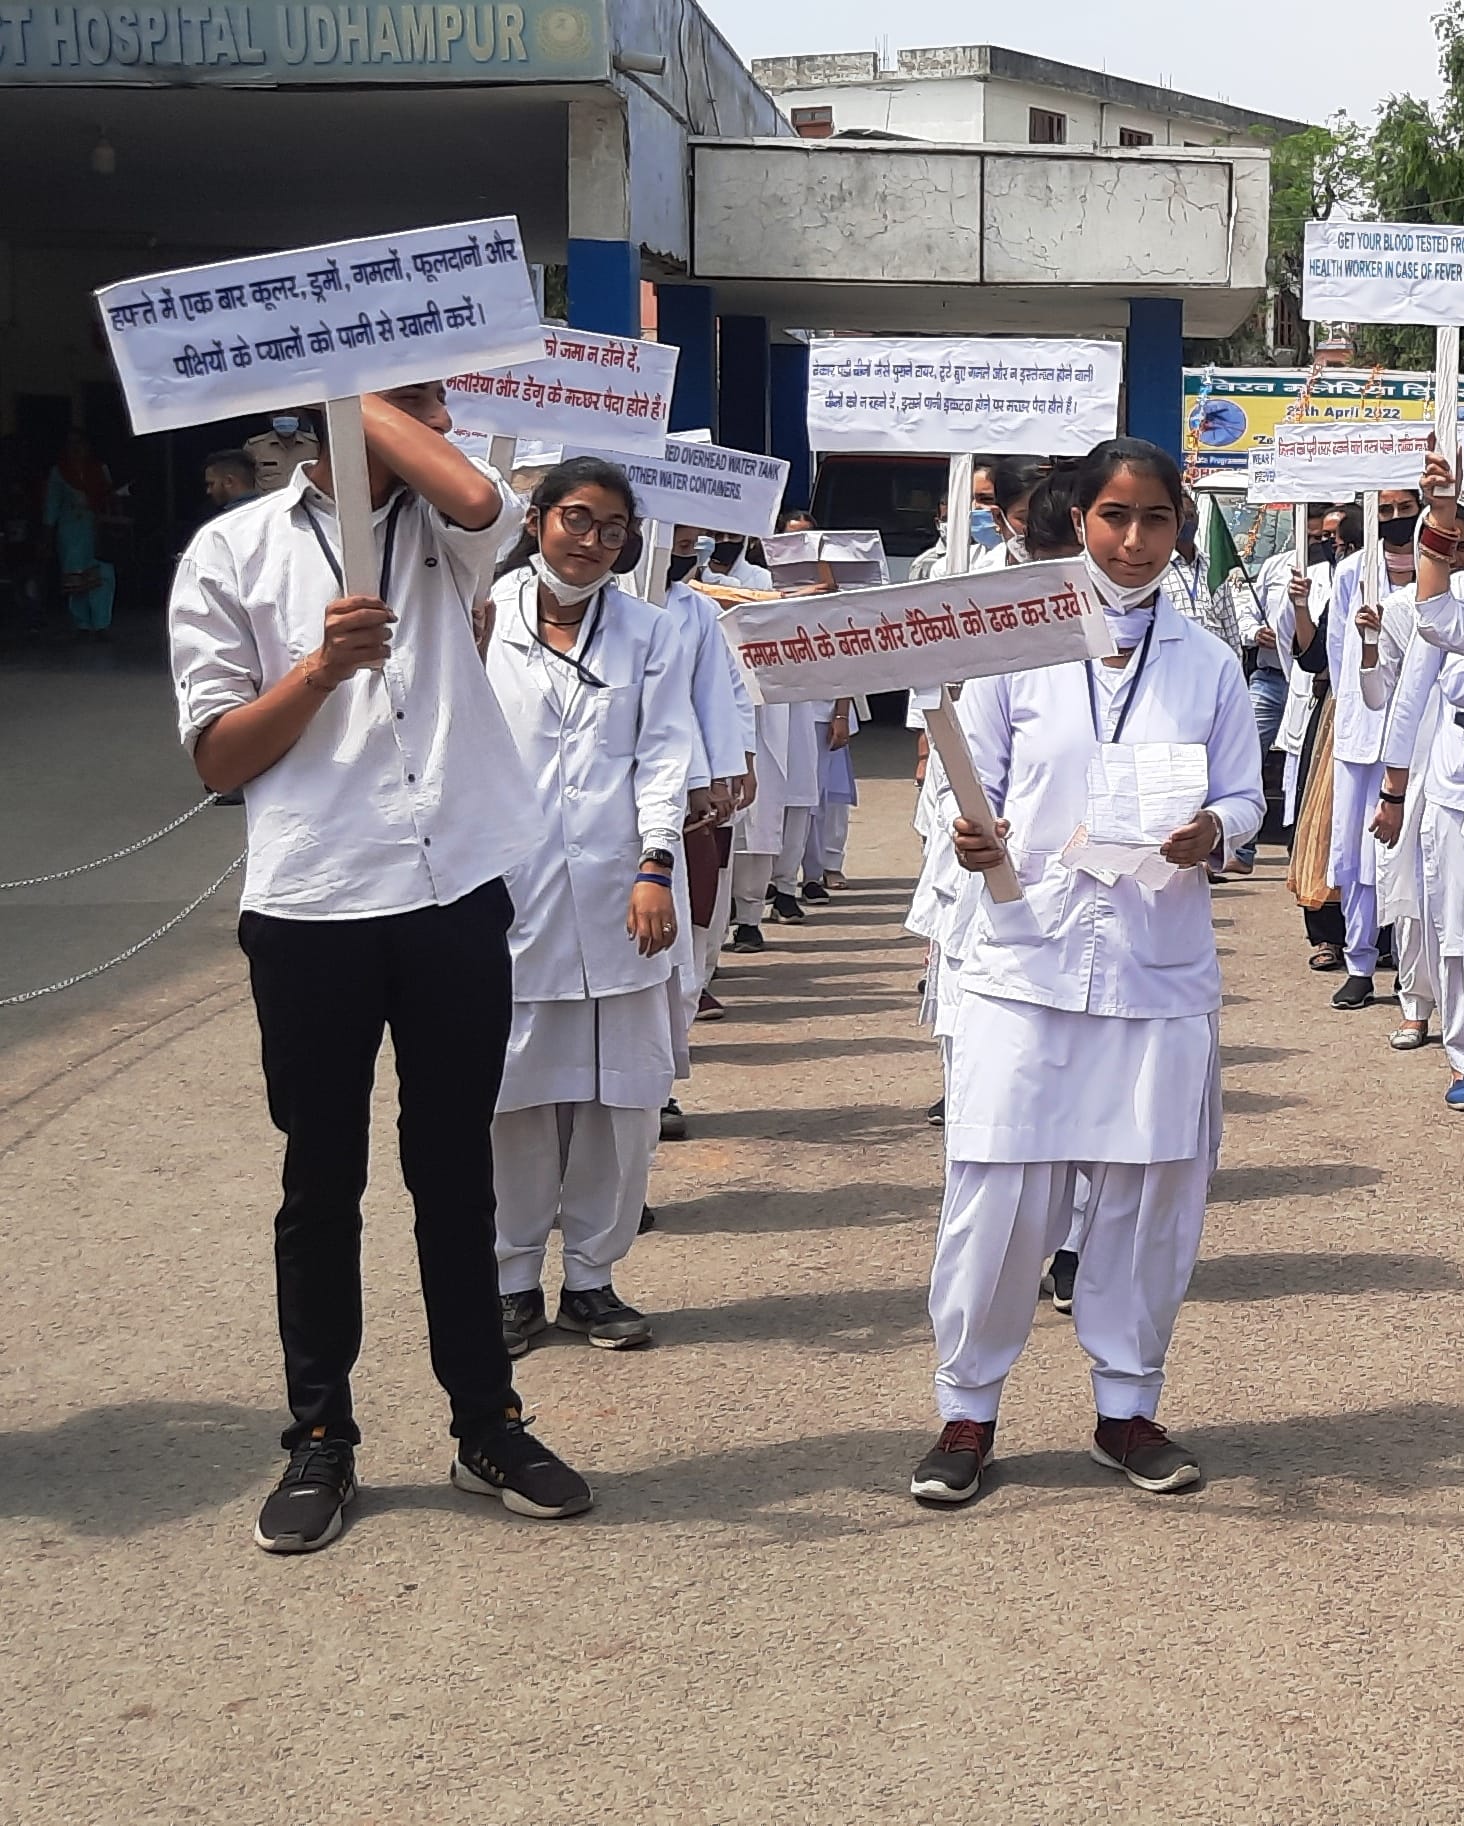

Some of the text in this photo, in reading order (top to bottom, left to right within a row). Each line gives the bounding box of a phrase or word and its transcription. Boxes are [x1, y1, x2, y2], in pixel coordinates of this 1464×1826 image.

[50, 4, 266, 67] HOSPITAL
[277, 4, 529, 65] UDHAMPUR
[1337, 231, 1355, 250] GET
[1356, 232, 1382, 251] YOUR
[1383, 233, 1414, 252] BLOOD
[1415, 234, 1449, 253] TESTED
[160, 288, 178, 319] में
[180, 290, 213, 320] एक
[216, 285, 246, 312] बार
[484, 230, 518, 264] और
[1309, 258, 1343, 278] HEALTH
[1344, 259, 1383, 279] WORKER
[1384, 261, 1394, 279] IN
[1395, 262, 1419, 280] CASE
[1420, 263, 1433, 280] OF
[1434, 264, 1463, 282] FEVER
[173, 340, 226, 379] पक्षियों
[230, 334, 253, 367] के
[255, 326, 305, 362] प्यालों
[308, 320, 335, 353] को
[337, 312, 374, 350] पानी
[377, 307, 394, 341] से
[560, 341, 585, 362] जमा
[587, 346, 598, 364] न
[496, 370, 520, 398] और
[547, 378, 562, 404] के
[603, 385, 624, 415] पैदा
[626, 389, 649, 417] होते
[1325, 406, 1359, 419] April
[628, 465, 657, 487] OTHER
[659, 470, 689, 492] WATER
[681, 447, 727, 471] OVERHEAD
[728, 456, 757, 476] WATER
[758, 461, 781, 481] TANK
[738, 641, 783, 670] तमाम
[781, 626, 818, 665] पानी
[813, 622, 836, 660] के
[834, 617, 876, 656] बर्तन
[876, 611, 908, 651] और
[959, 598, 987, 637] को
[985, 604, 1019, 633] ढक
[1017, 598, 1051, 626] कर
